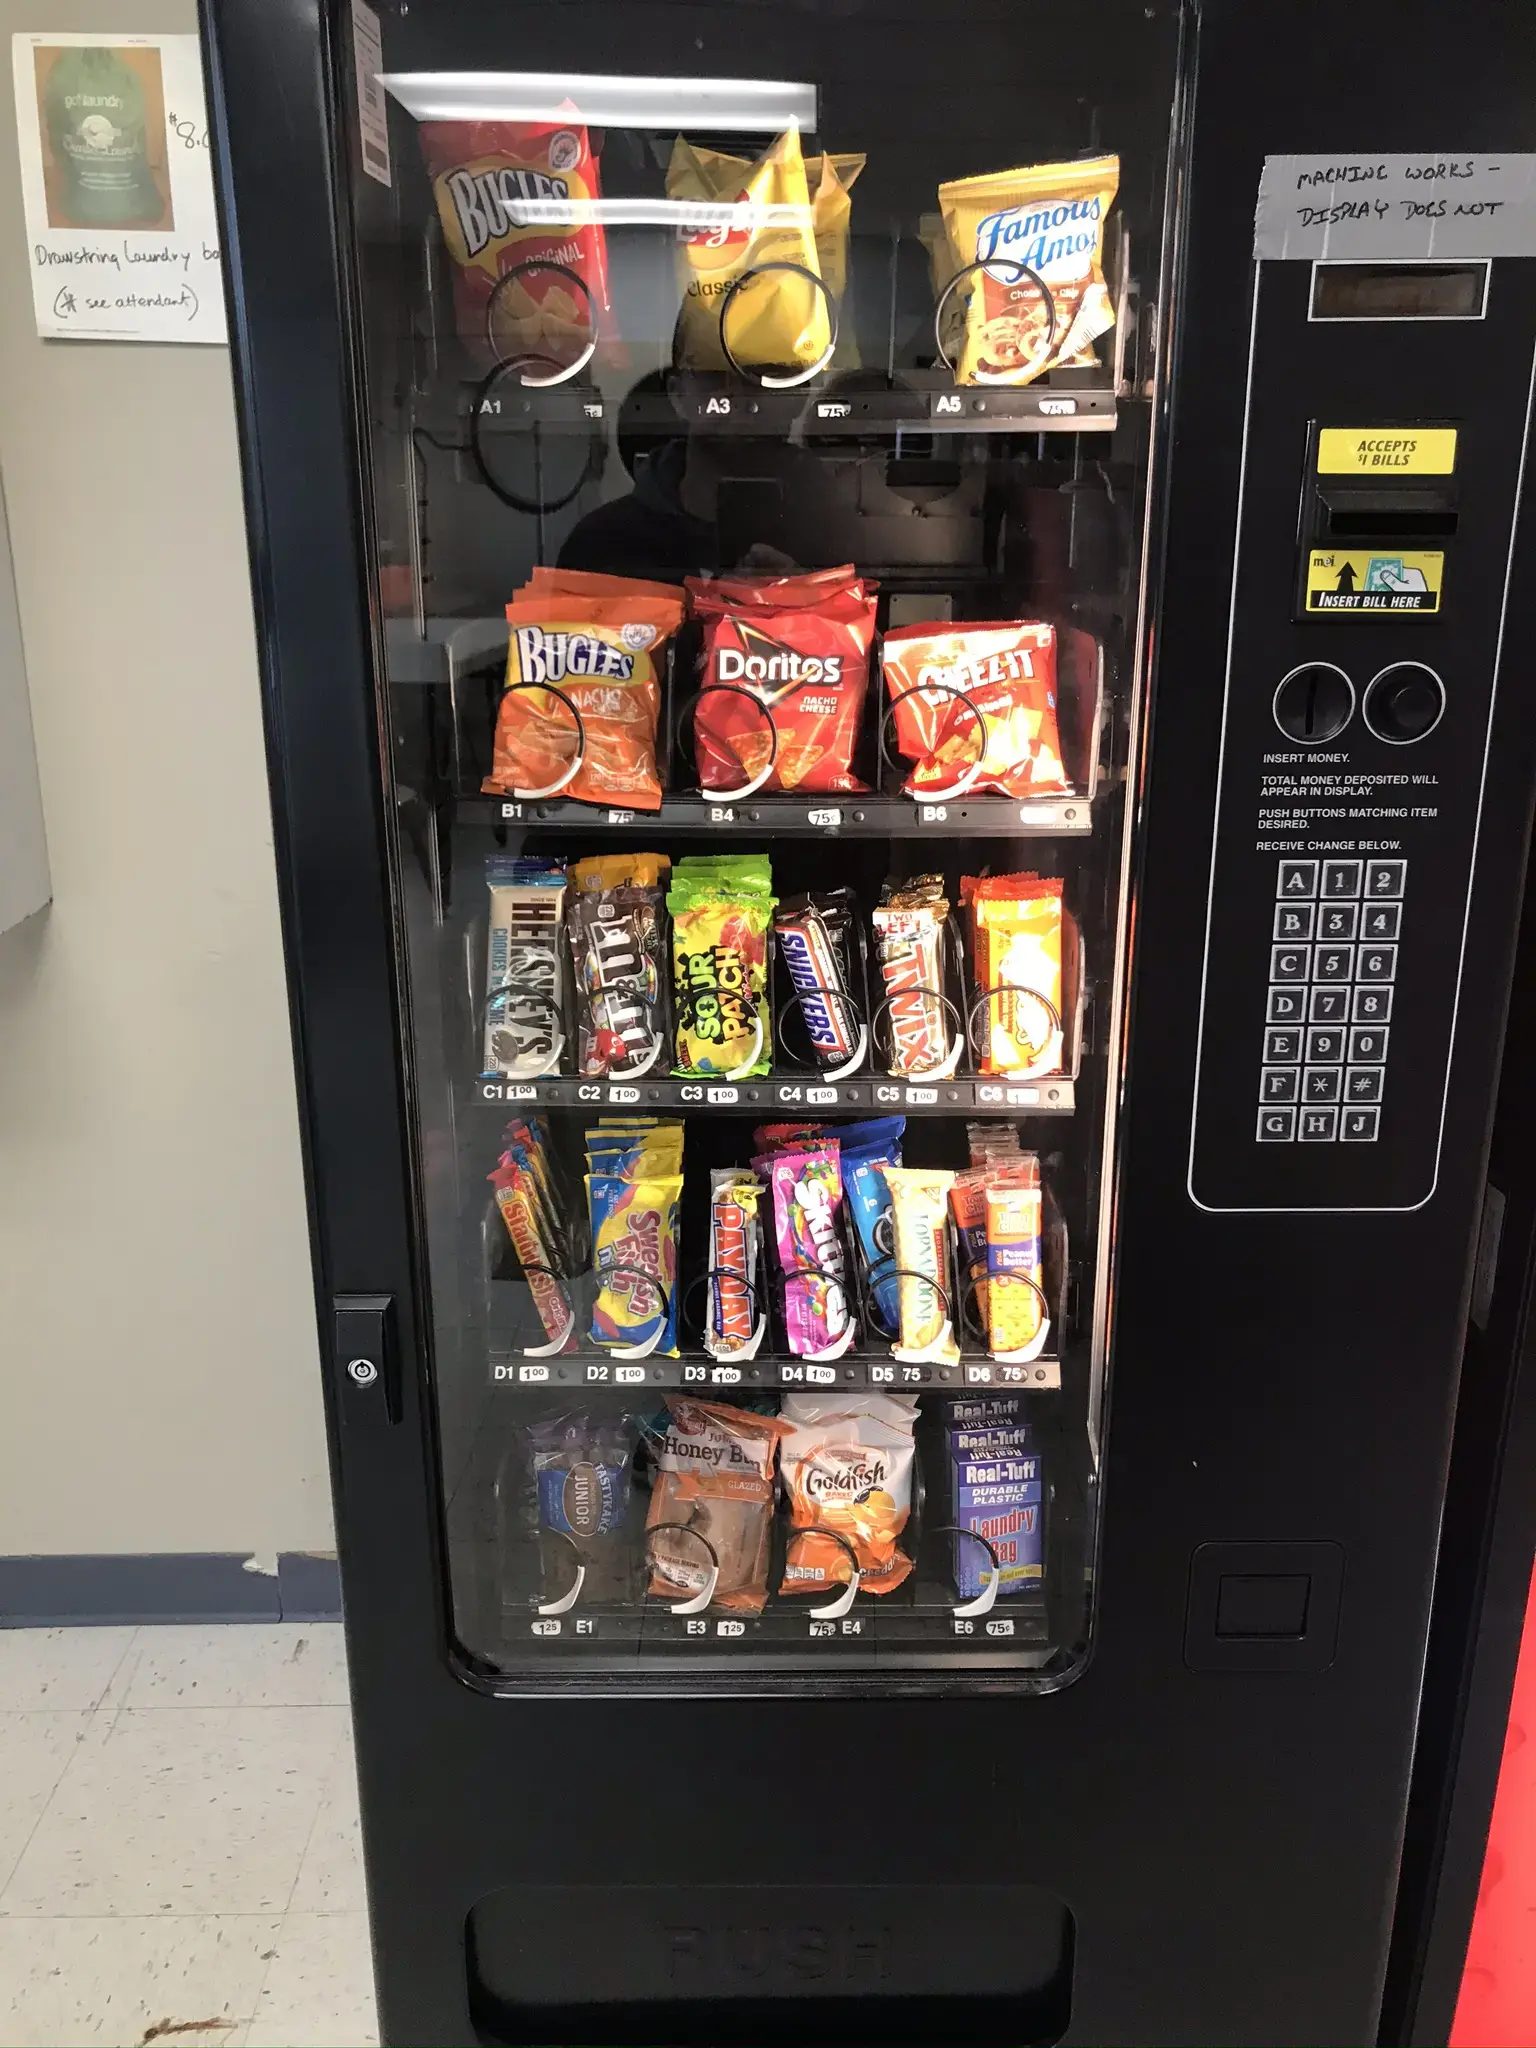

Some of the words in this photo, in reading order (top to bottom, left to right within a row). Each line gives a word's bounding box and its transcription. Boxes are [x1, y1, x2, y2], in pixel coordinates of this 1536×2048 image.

[1298, 165, 1387, 189] MACHINE
[1406, 162, 1474, 180] WORKS
[1297, 199, 1389, 227] DISPLAY
[1400, 200, 1447, 220] DOES
[1454, 202, 1504, 216] NOT
[976, 196, 1101, 261] Famous
[1006, 231, 1098, 283] Amos
[480, 401, 501, 414] A1
[706, 398, 730, 414] A3
[937, 396, 961, 412] A5
[1357, 441, 1417, 452] ACCEPTS
[1358, 454, 1367, 466] $1
[1371, 455, 1410, 466] BILLS
[1362, 596, 1387, 608] BILL
[1390, 597, 1421, 608] HERE
[516, 626, 634, 683] BUGLES
[718, 649, 841, 683] Doritos
[803, 696, 837, 704] NACHO
[799, 705, 837, 714] CHEESE
[1263, 754, 1305, 763] INSERT
[1307, 754, 1350, 763] MONEY.
[1262, 776, 1298, 785] TOTAL
[1300, 776, 1342, 785] MONEY
[1344, 775, 1408, 784] DEPOSITED
[1412, 775, 1439, 784] WILL
[1260, 787, 1307, 796] APPEAR
[1310, 787, 1321, 796] IN
[1324, 787, 1373, 796] DISPLAY.
[502, 805, 522, 817] B1
[712, 809, 734, 821] B4
[924, 807, 947, 821] B6
[1259, 809, 1290, 818] PUSH
[1292, 808, 1346, 817] BUTTONS
[1348, 808, 1408, 817] MATCHING
[1410, 808, 1438, 817] ITEM
[1258, 820, 1310, 829] DESIRED.
[1256, 842, 1304, 850] RECEIVE
[1307, 841, 1355, 850] CHANGE
[1358, 841, 1401, 850] BELOW.
[1286, 872, 1305, 888] A
[1335, 872, 1344, 888] 1
[1376, 872, 1391, 888] 2
[1284, 914, 1300, 930] B
[1329, 914, 1343, 930] 3
[1373, 914, 1386, 930] 4
[1280, 955, 1297, 971] C
[1326, 955, 1340, 971] 5
[1368, 955, 1382, 972] 6
[509, 902, 556, 1055] HERSHEY'S
[715, 947, 745, 1042] PATCH
[780, 932, 836, 1044] SNICKERS
[689, 953, 720, 1039] SOUR
[883, 944, 932, 1069] TWIX
[1277, 997, 1294, 1012] D
[1323, 997, 1335, 1012] 7
[1364, 996, 1378, 1012] 8
[1273, 1037, 1290, 1053] E
[1318, 1037, 1331, 1052] 9
[1360, 1037, 1373, 1052] 0
[483, 1085, 502, 1098] C1
[578, 1086, 600, 1099] C2
[1270, 1077, 1287, 1093] F
[681, 1087, 702, 1100] C3
[780, 1087, 801, 1101] C4
[877, 1087, 899, 1101] C5
[980, 1087, 1002, 1101] C6
[1266, 1117, 1283, 1132] G
[1307, 1117, 1325, 1132] H
[1352, 1117, 1366, 1132] J
[503, 1201, 556, 1297] Starburst
[610, 1234, 641, 1294] Fish
[713, 1203, 753, 1340] PAYDAY
[494, 1366, 513, 1379] D1
[587, 1367, 608, 1379] D2
[685, 1367, 705, 1380] D3
[782, 1367, 803, 1380] D4
[873, 1368, 894, 1381] D5
[902, 1367, 921, 1380] 75
[969, 1368, 990, 1381] D6
[1003, 1367, 1022, 1379] 75
[958, 1429, 1026, 1448] Real-Tuff
[664, 1436, 725, 1466] Honey
[806, 1461, 886, 1496] Goldfish
[966, 1461, 1036, 1483] Real-Tuff
[728, 1480, 762, 1492] GLAZED
[972, 1485, 1028, 1497] DURABLE
[574, 1475, 589, 1526] JUNIOR
[593, 1461, 613, 1536] TASTYKAKE
[973, 1493, 1024, 1504] PLASTIC
[970, 1507, 1035, 1540] Laundry
[990, 1540, 1017, 1563] Bag
[576, 1621, 593, 1634] E1
[687, 1621, 706, 1634] E3
[842, 1621, 861, 1634] E4
[954, 1621, 974, 1633] E6
